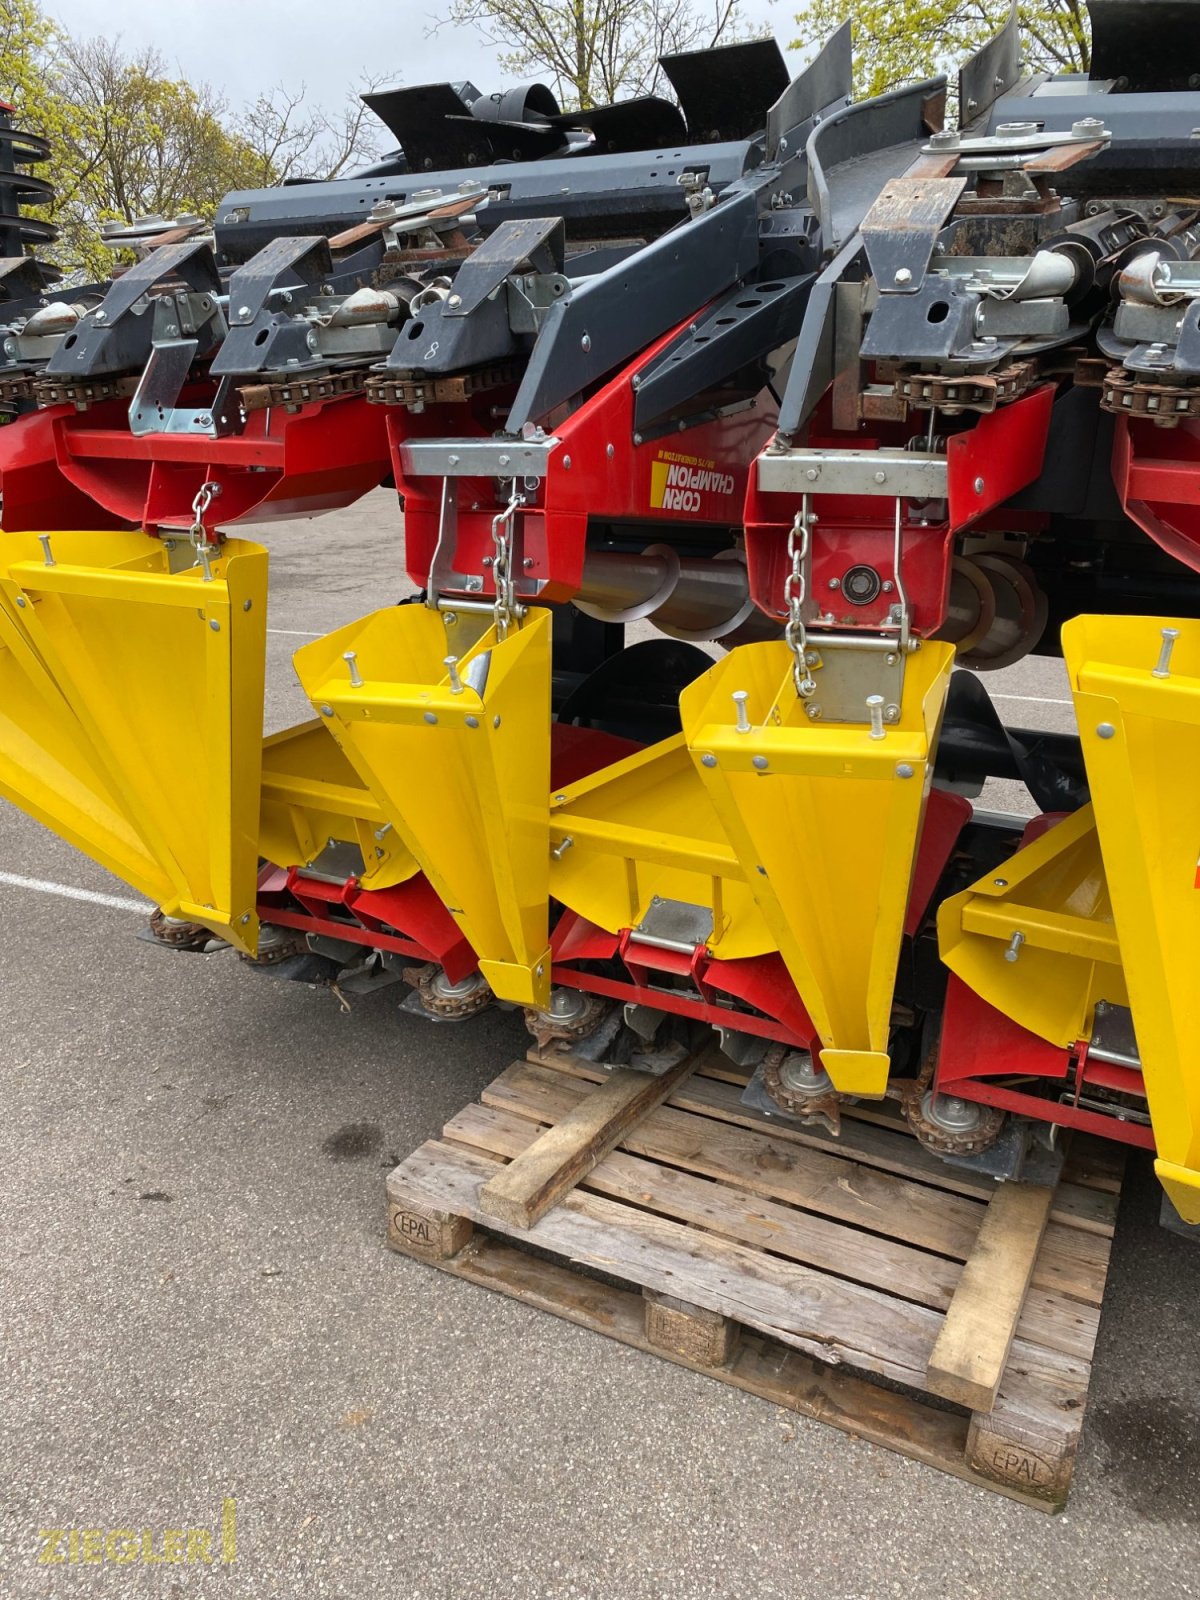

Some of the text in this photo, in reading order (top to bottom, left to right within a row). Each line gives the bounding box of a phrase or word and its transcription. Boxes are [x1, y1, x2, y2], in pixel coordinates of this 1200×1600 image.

[424, 341, 439, 360] 8
[667, 464, 735, 495] CHAMPION
[662, 488, 701, 512] CORN
[401, 1215, 434, 1243] EPAL
[993, 1451, 1041, 1483] EPAL
